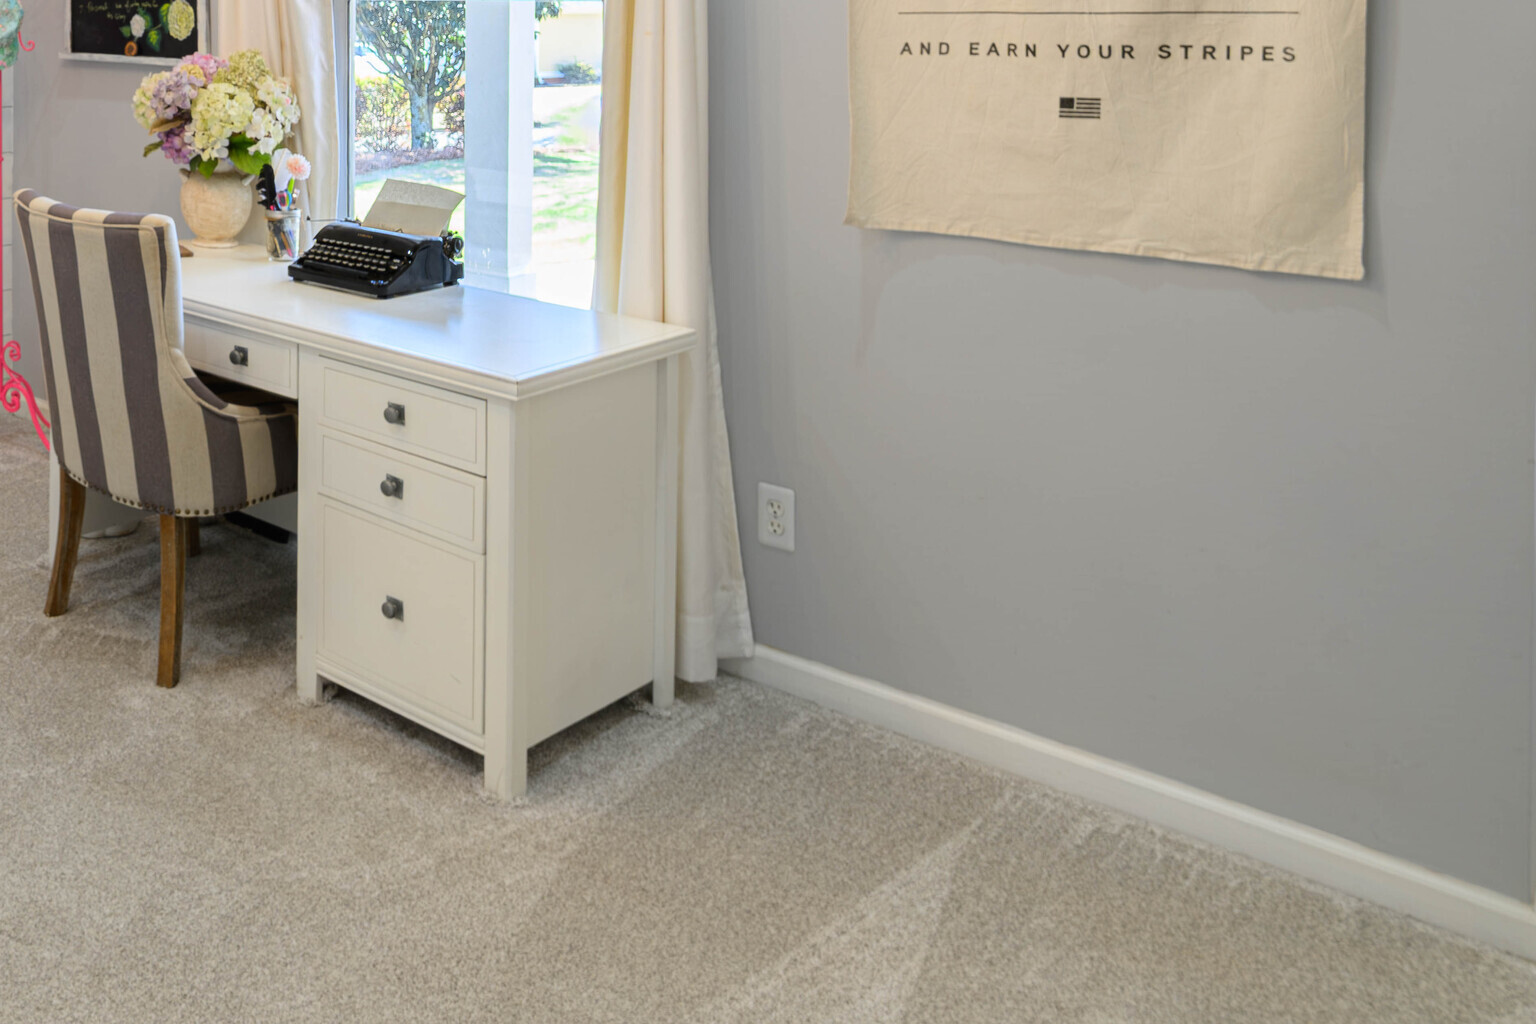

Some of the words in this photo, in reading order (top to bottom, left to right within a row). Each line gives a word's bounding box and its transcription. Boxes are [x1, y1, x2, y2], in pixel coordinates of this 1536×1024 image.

[900, 40, 951, 57] AND
[969, 42, 1038, 58] EARN
[1057, 45, 1136, 60] YOUR
[1158, 45, 1297, 62] STRIPES
